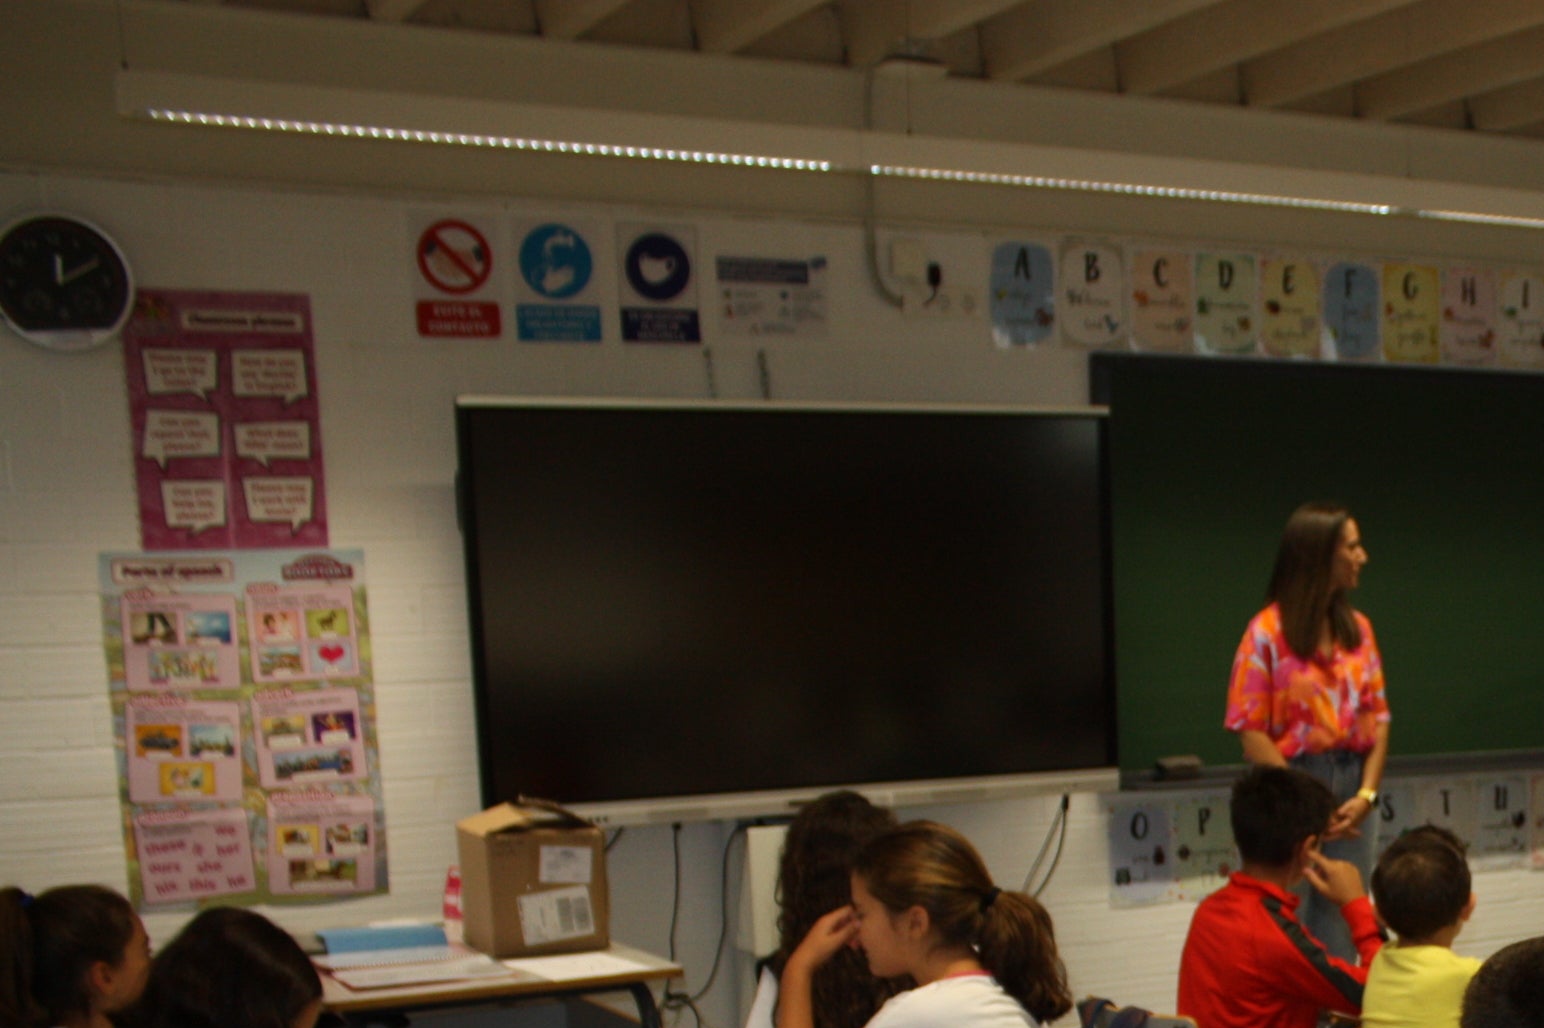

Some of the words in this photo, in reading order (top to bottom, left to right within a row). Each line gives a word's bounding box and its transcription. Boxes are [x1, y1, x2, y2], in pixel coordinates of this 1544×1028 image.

[1014, 246, 1031, 281] A
[1085, 251, 1100, 283] B
[1153, 257, 1168, 288] C
[1218, 260, 1233, 290] D
[1282, 264, 1296, 294] E
[1344, 268, 1357, 297] F
[1461, 276, 1476, 306] H
[1521, 278, 1529, 309] I
[1130, 811, 1148, 841] O
[1198, 807, 1211, 836] P
[1381, 796, 1395, 822] S
[1439, 788, 1450, 816] T
[1493, 786, 1508, 811] U
